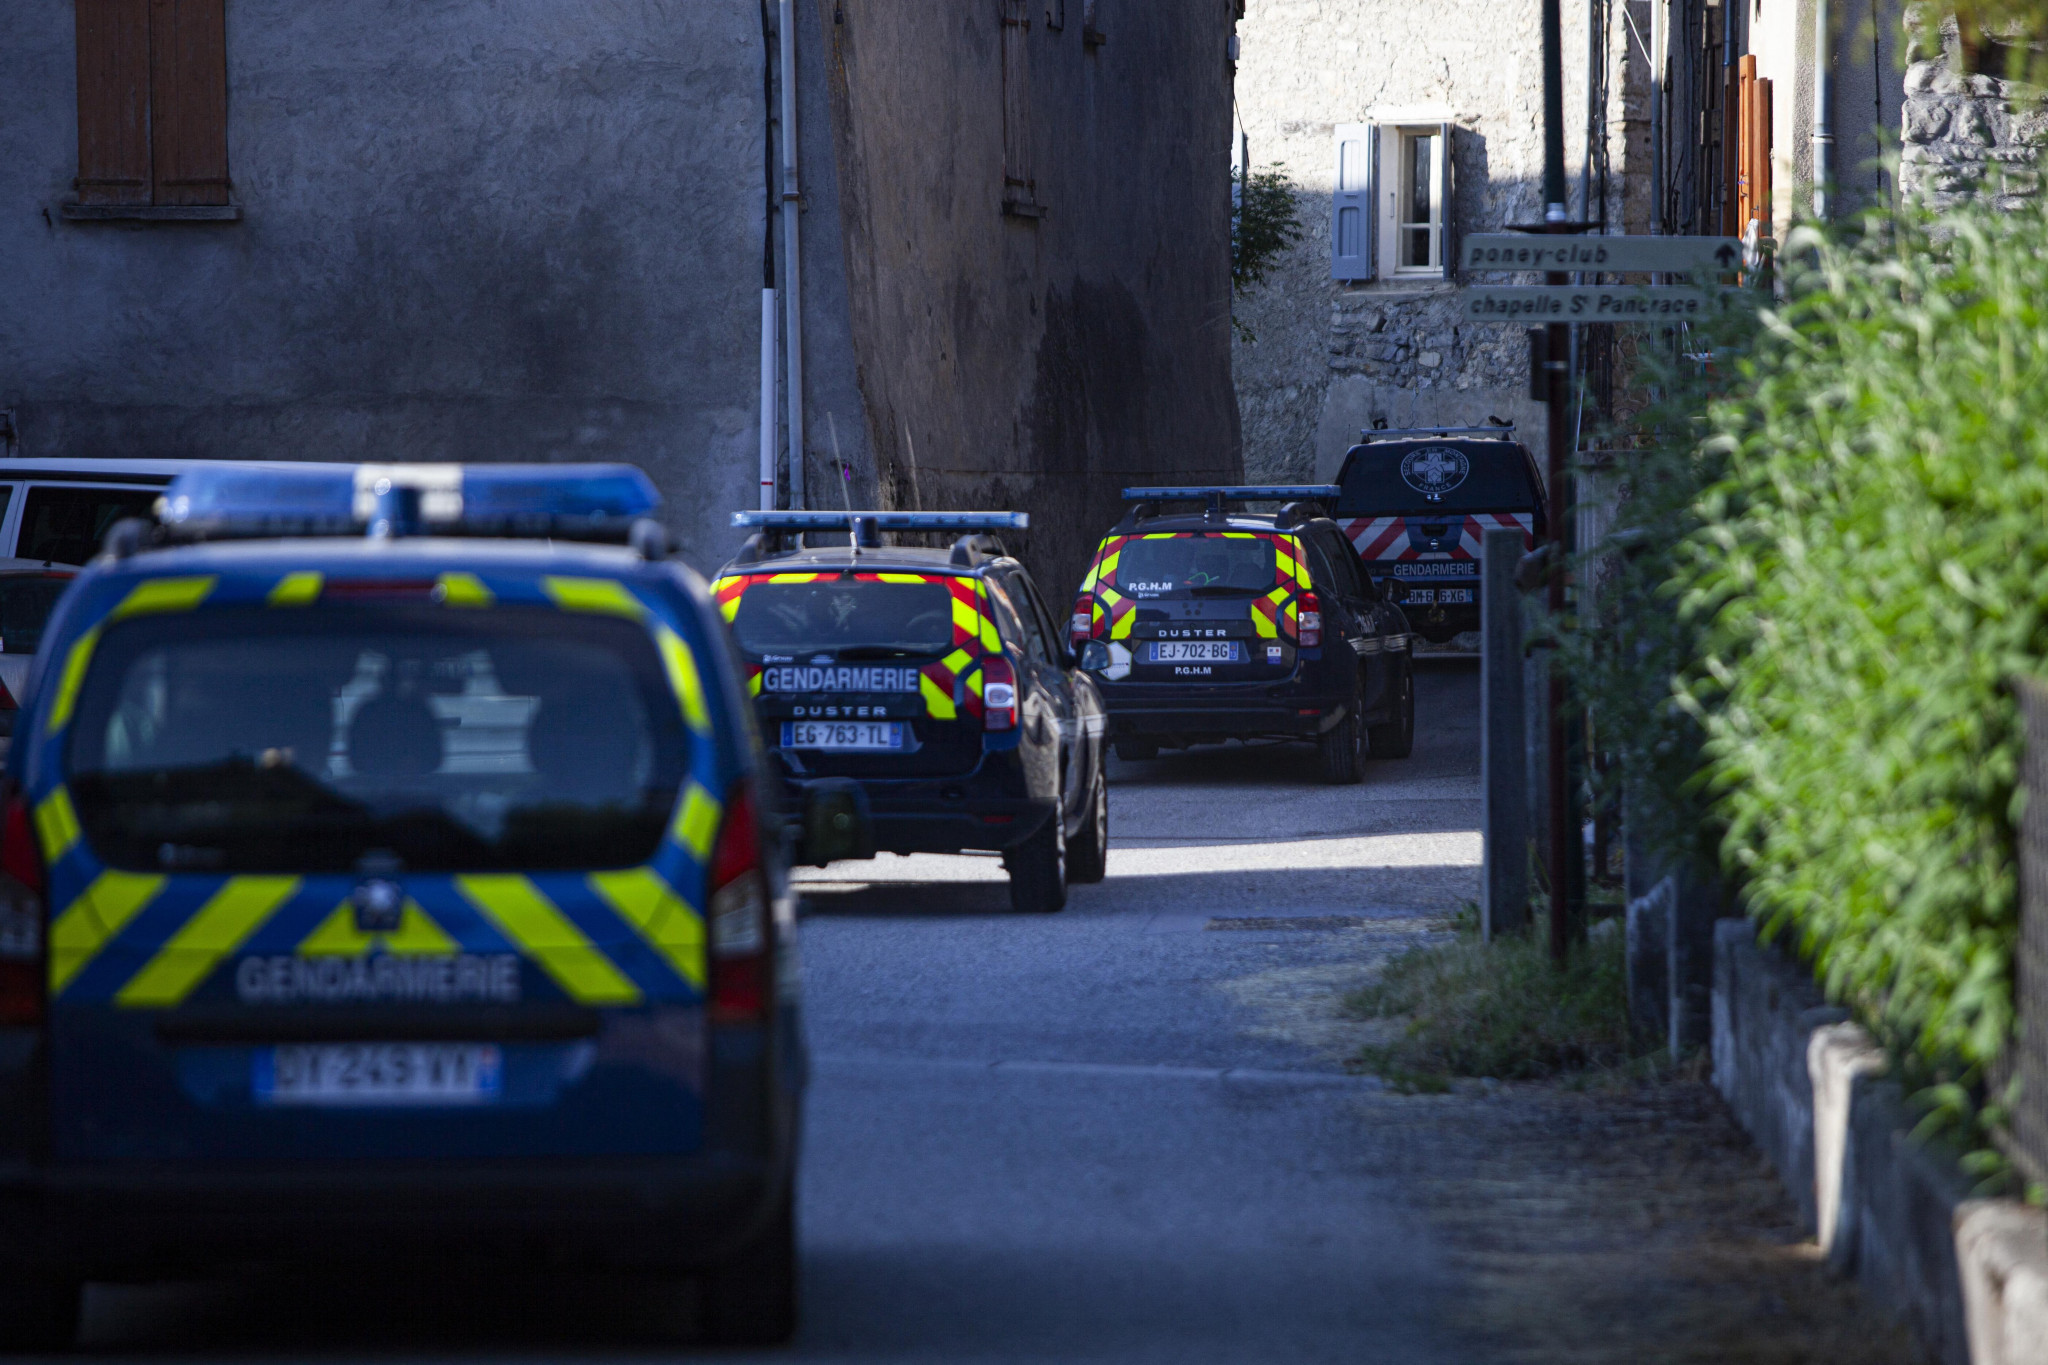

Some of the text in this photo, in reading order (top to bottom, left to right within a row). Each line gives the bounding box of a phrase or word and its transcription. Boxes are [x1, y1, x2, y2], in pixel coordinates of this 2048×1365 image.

[1469, 244, 1608, 266] poney-club
[1470, 294, 1561, 317] chapelle
[1418, 481, 1453, 492] FRANCE
[1393, 563, 1475, 576] GENDARMERIE
[1128, 581, 1173, 591] P.G.H.M
[1408, 590, 1465, 603] BM-66-XG
[1158, 628, 1227, 637] DUSTER
[1159, 643, 1228, 658] EJ-702-BG
[1175, 666, 1212, 675] P.G.H.M
[763, 667, 919, 691] GENDARMERIE
[793, 706, 887, 717] DUSTER
[794, 724, 888, 744] EG-763-TL
[236, 953, 519, 998] GENDARMERIE
